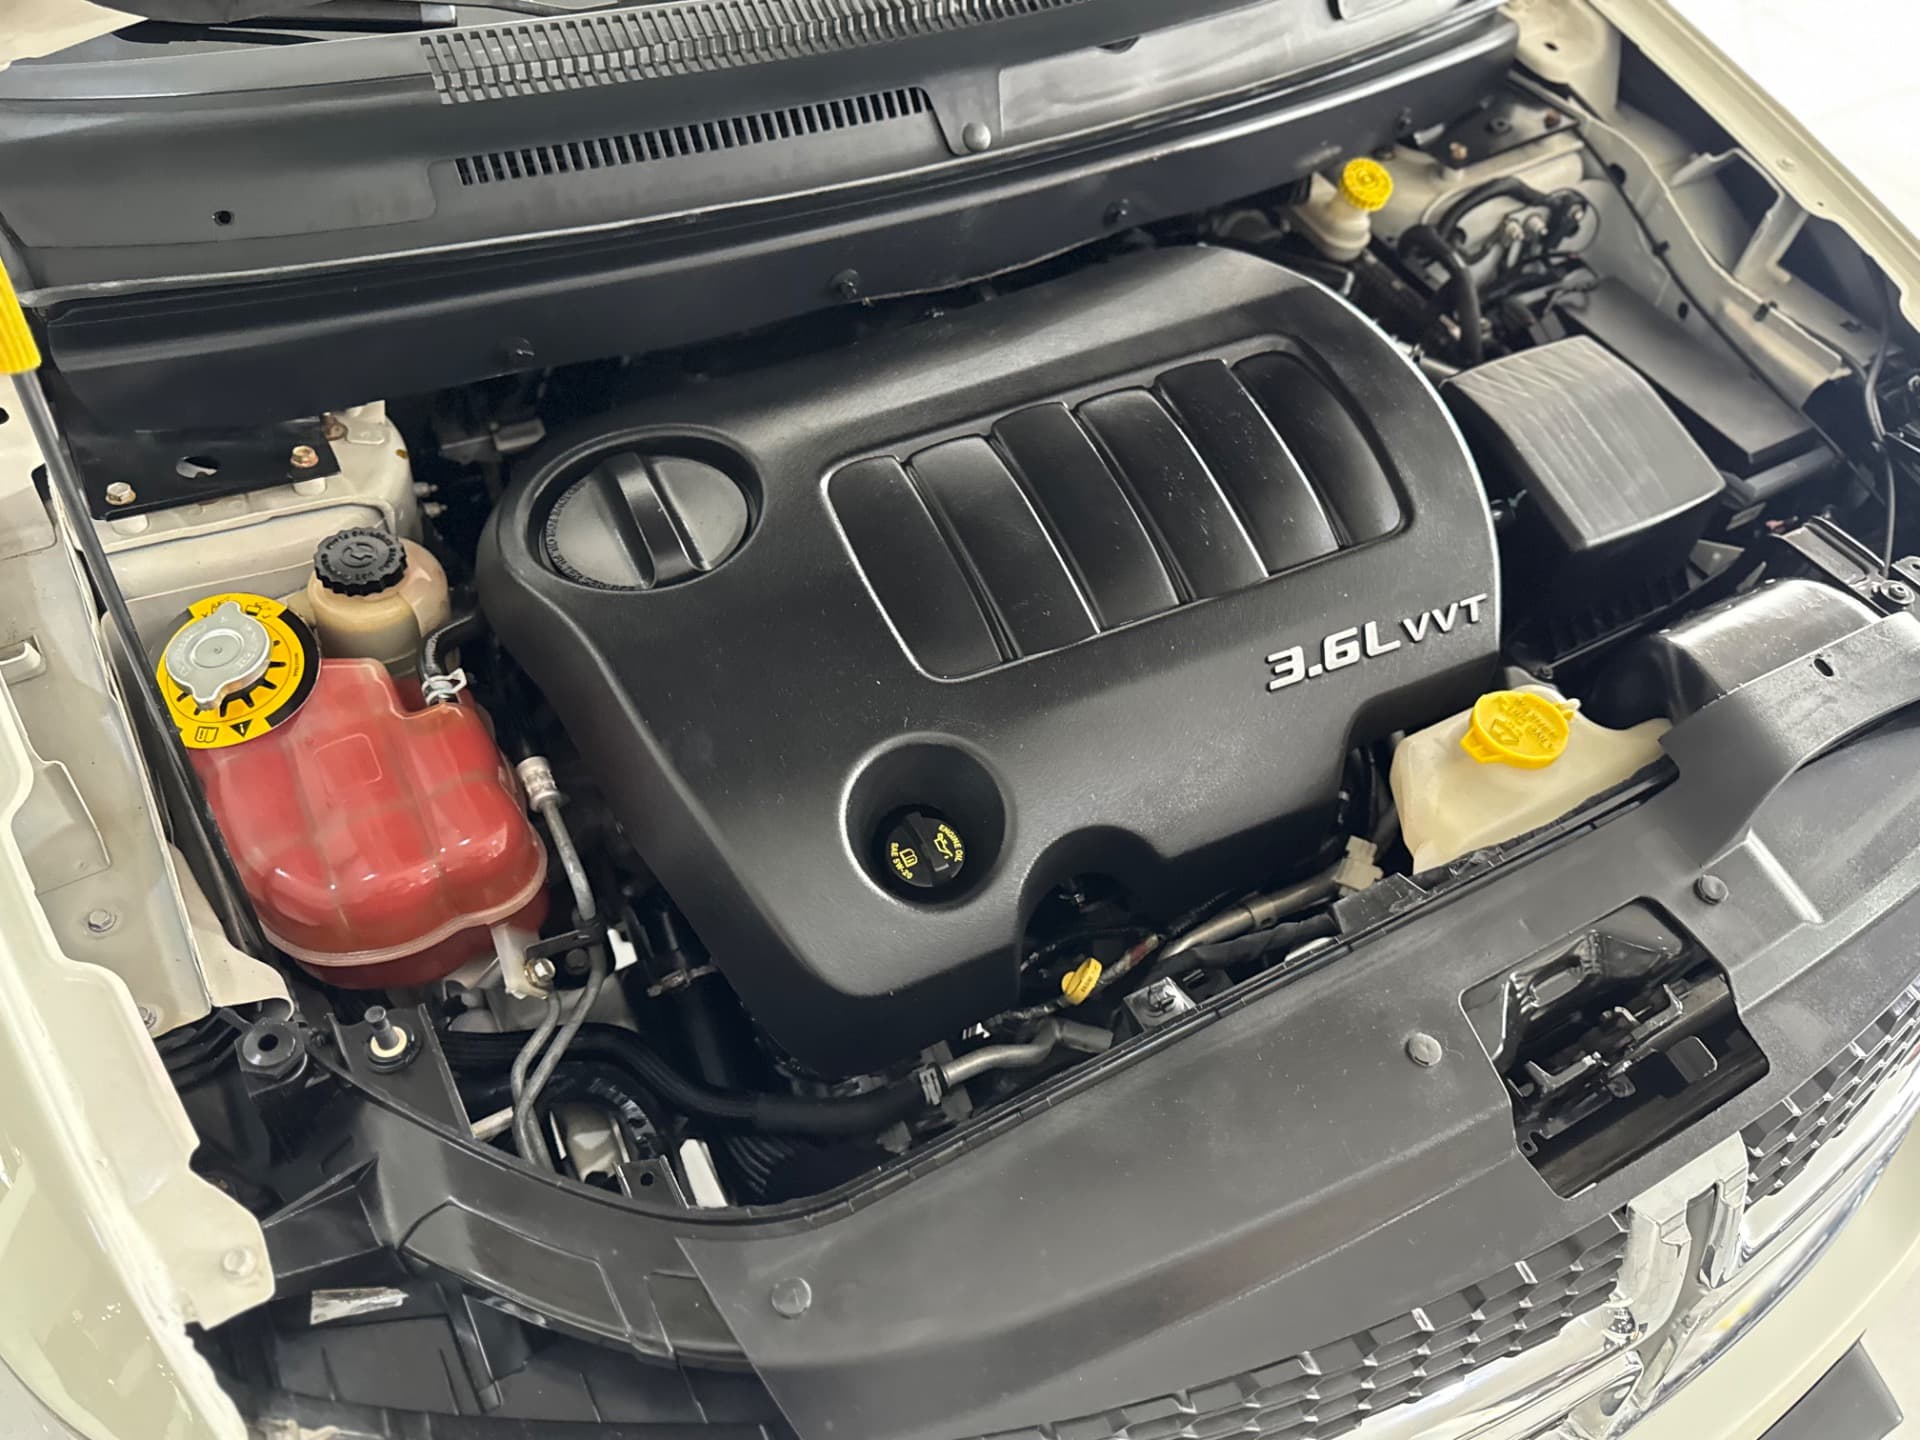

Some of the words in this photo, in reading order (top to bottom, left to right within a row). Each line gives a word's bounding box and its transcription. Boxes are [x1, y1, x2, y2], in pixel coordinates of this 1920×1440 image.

[1266, 620, 1401, 691] 3.6L
[1401, 593, 1488, 643] VVT
[939, 824, 962, 849] ENGINE
[954, 849, 964, 863] OIL
